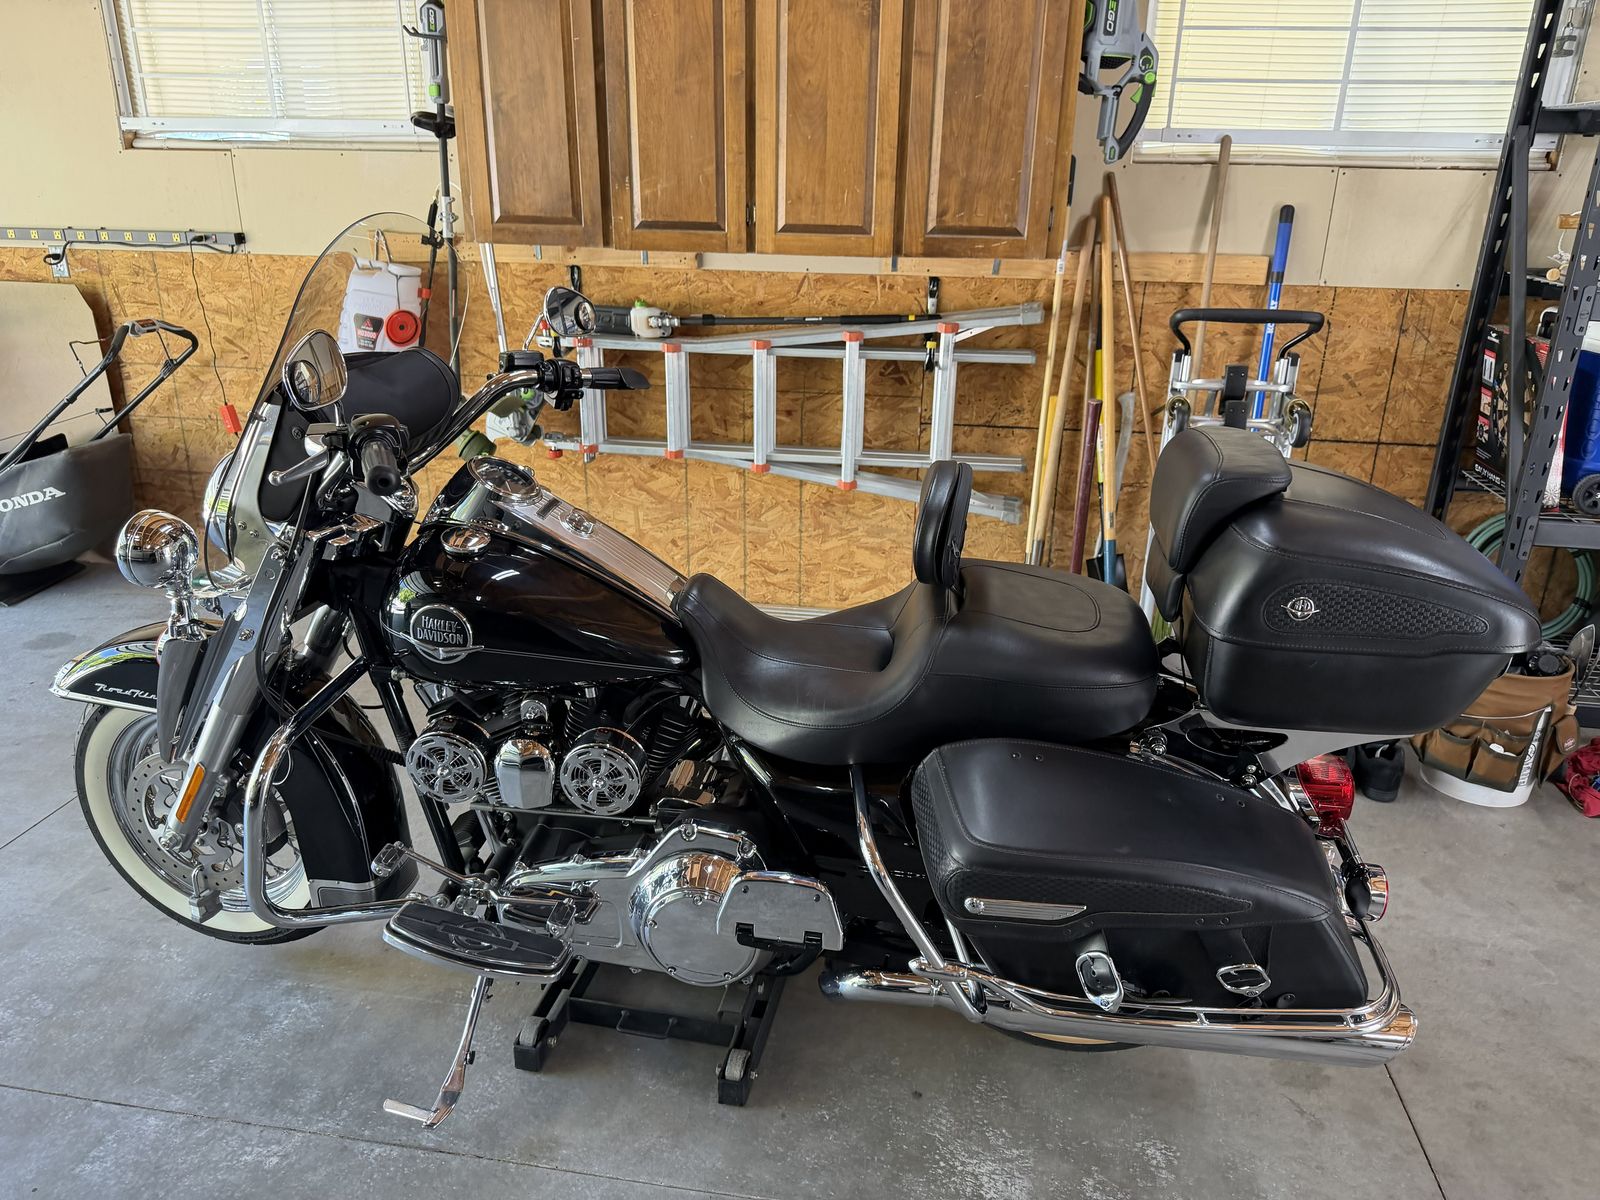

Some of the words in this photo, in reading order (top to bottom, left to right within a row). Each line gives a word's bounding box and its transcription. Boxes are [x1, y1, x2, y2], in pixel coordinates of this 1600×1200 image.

[1106, 0, 1118, 32] EGO
[0, 486, 66, 512] ONDA
[421, 615, 462, 633] HARLEY-
[416, 627, 464, 645] DAVIDSON
